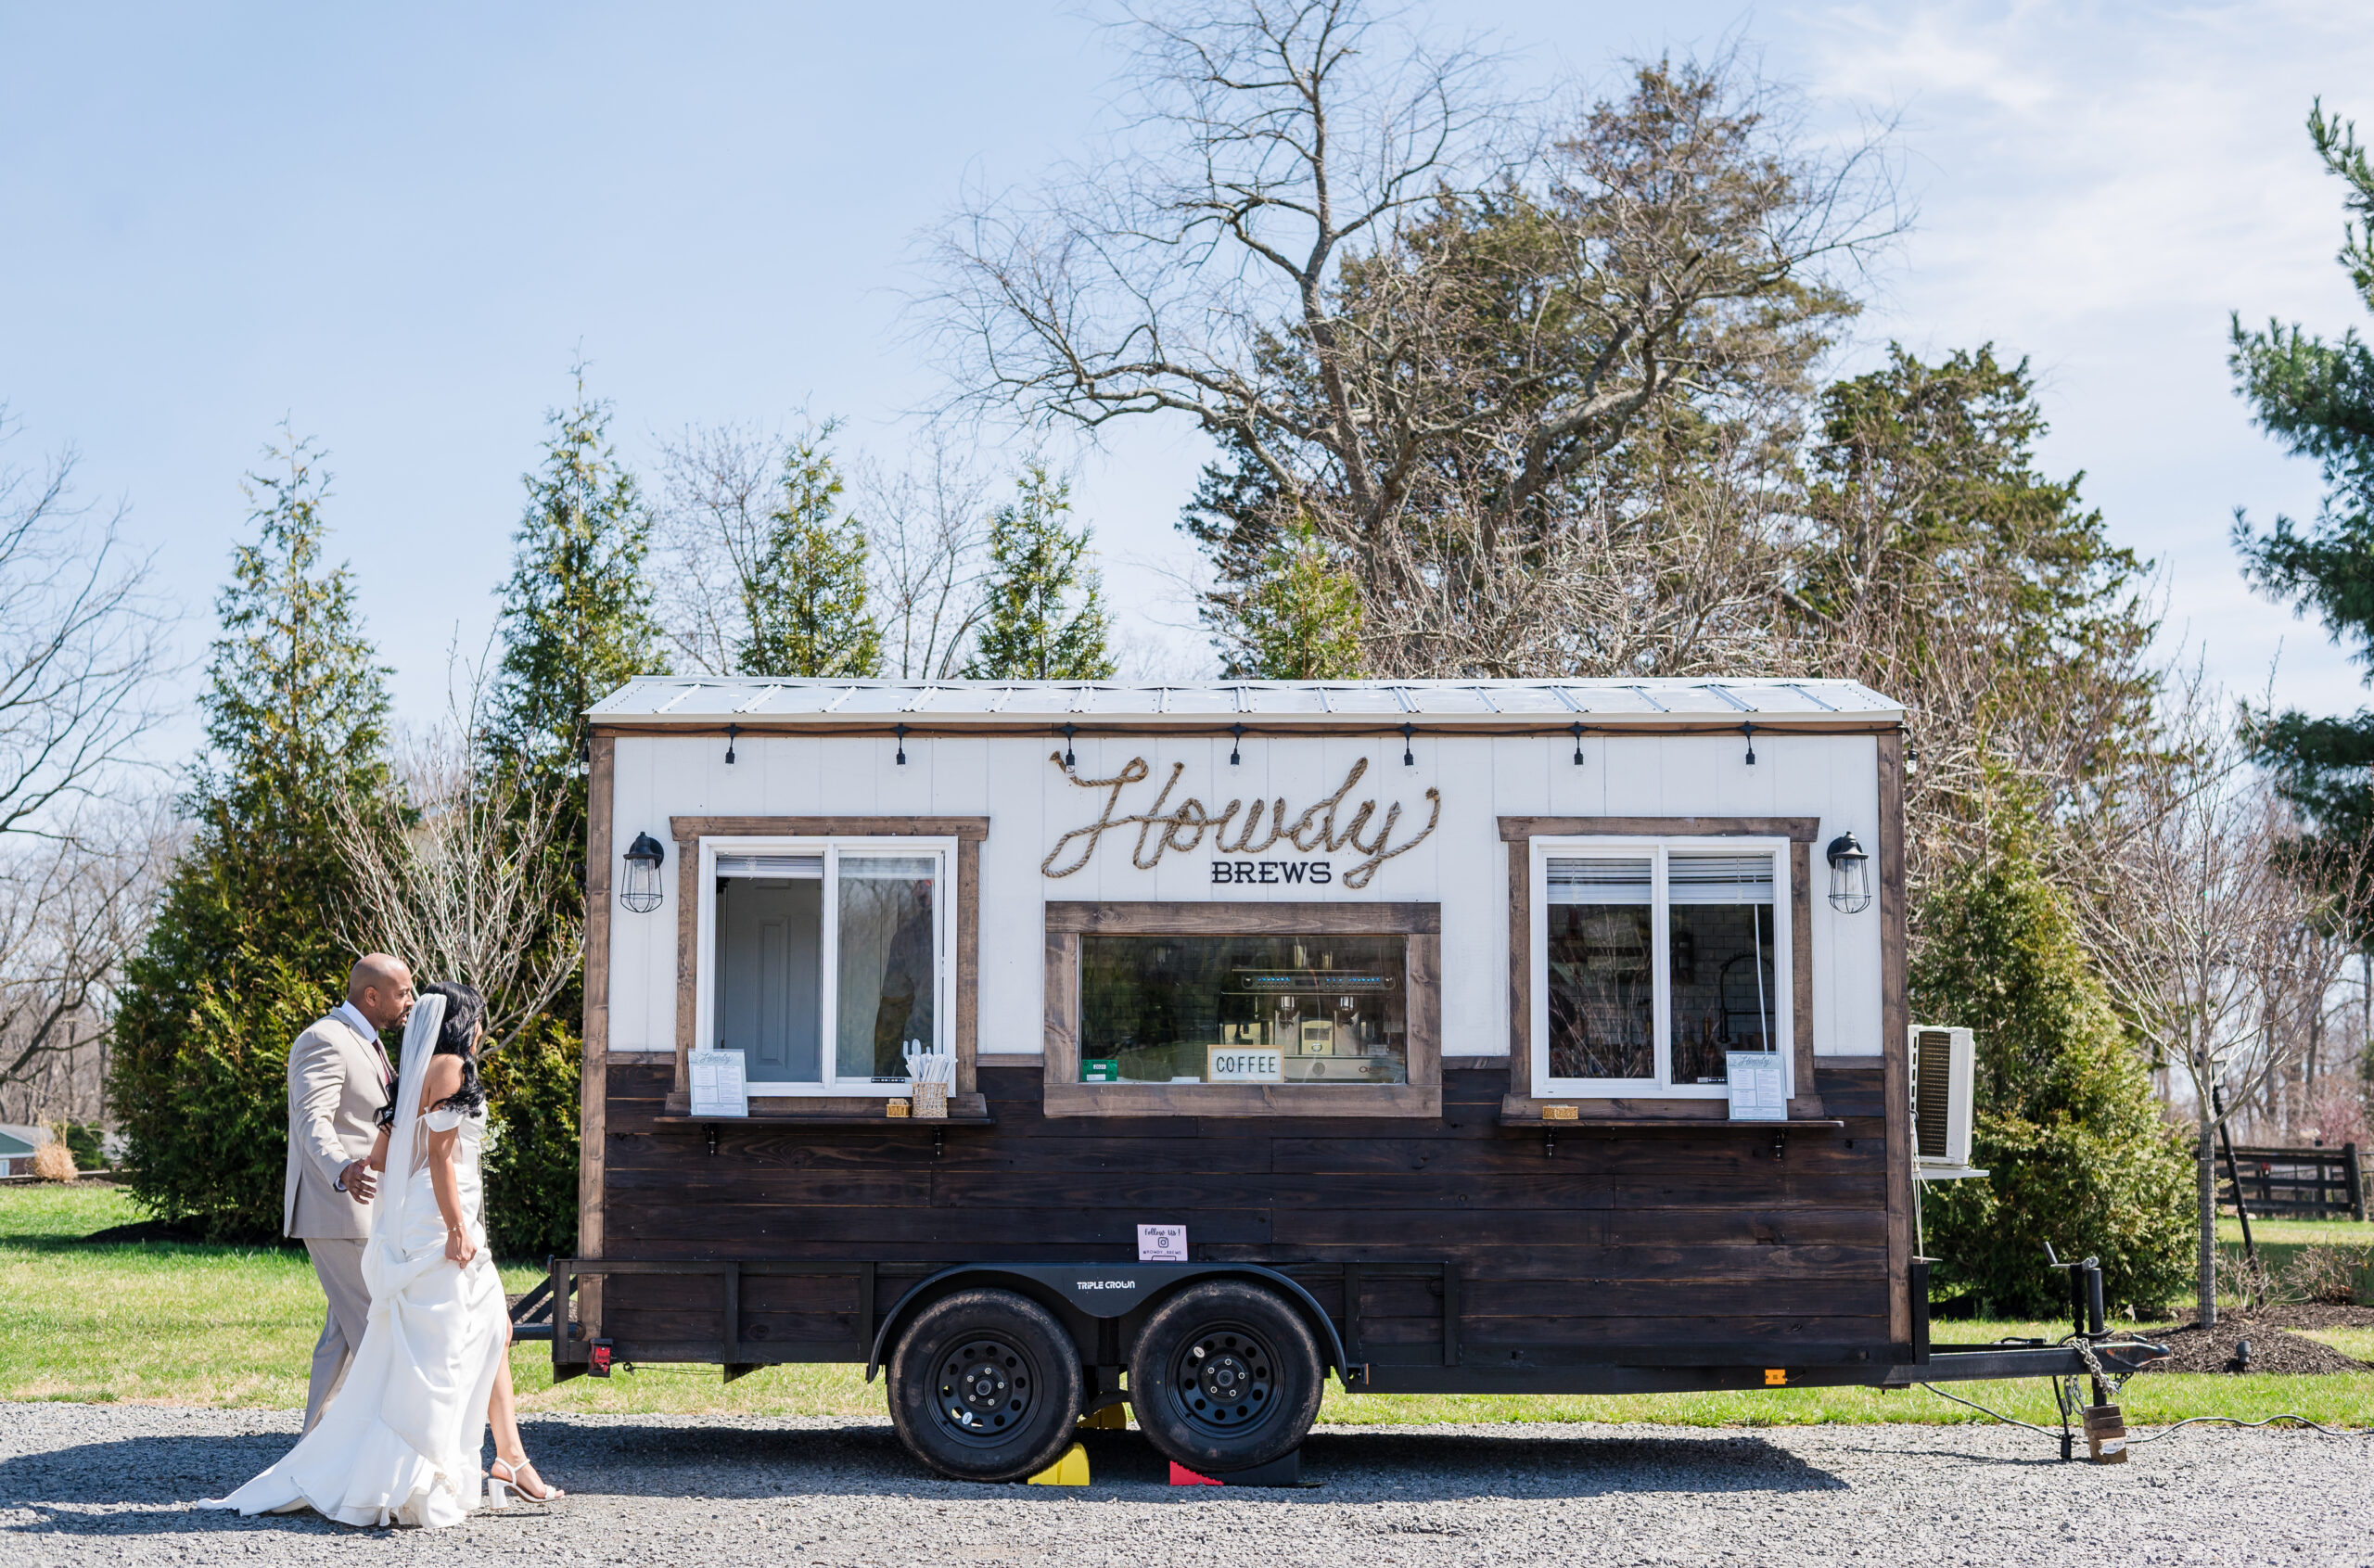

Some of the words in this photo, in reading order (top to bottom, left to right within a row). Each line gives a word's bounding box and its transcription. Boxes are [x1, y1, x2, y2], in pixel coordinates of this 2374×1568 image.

[1041, 750, 1441, 889] Howdy
[1211, 861, 1332, 884] BREWS
[1216, 1056, 1276, 1073] COFFEE
[1077, 1281, 1104, 1290] TRIPLE
[1104, 1281, 1135, 1289] CROWN
